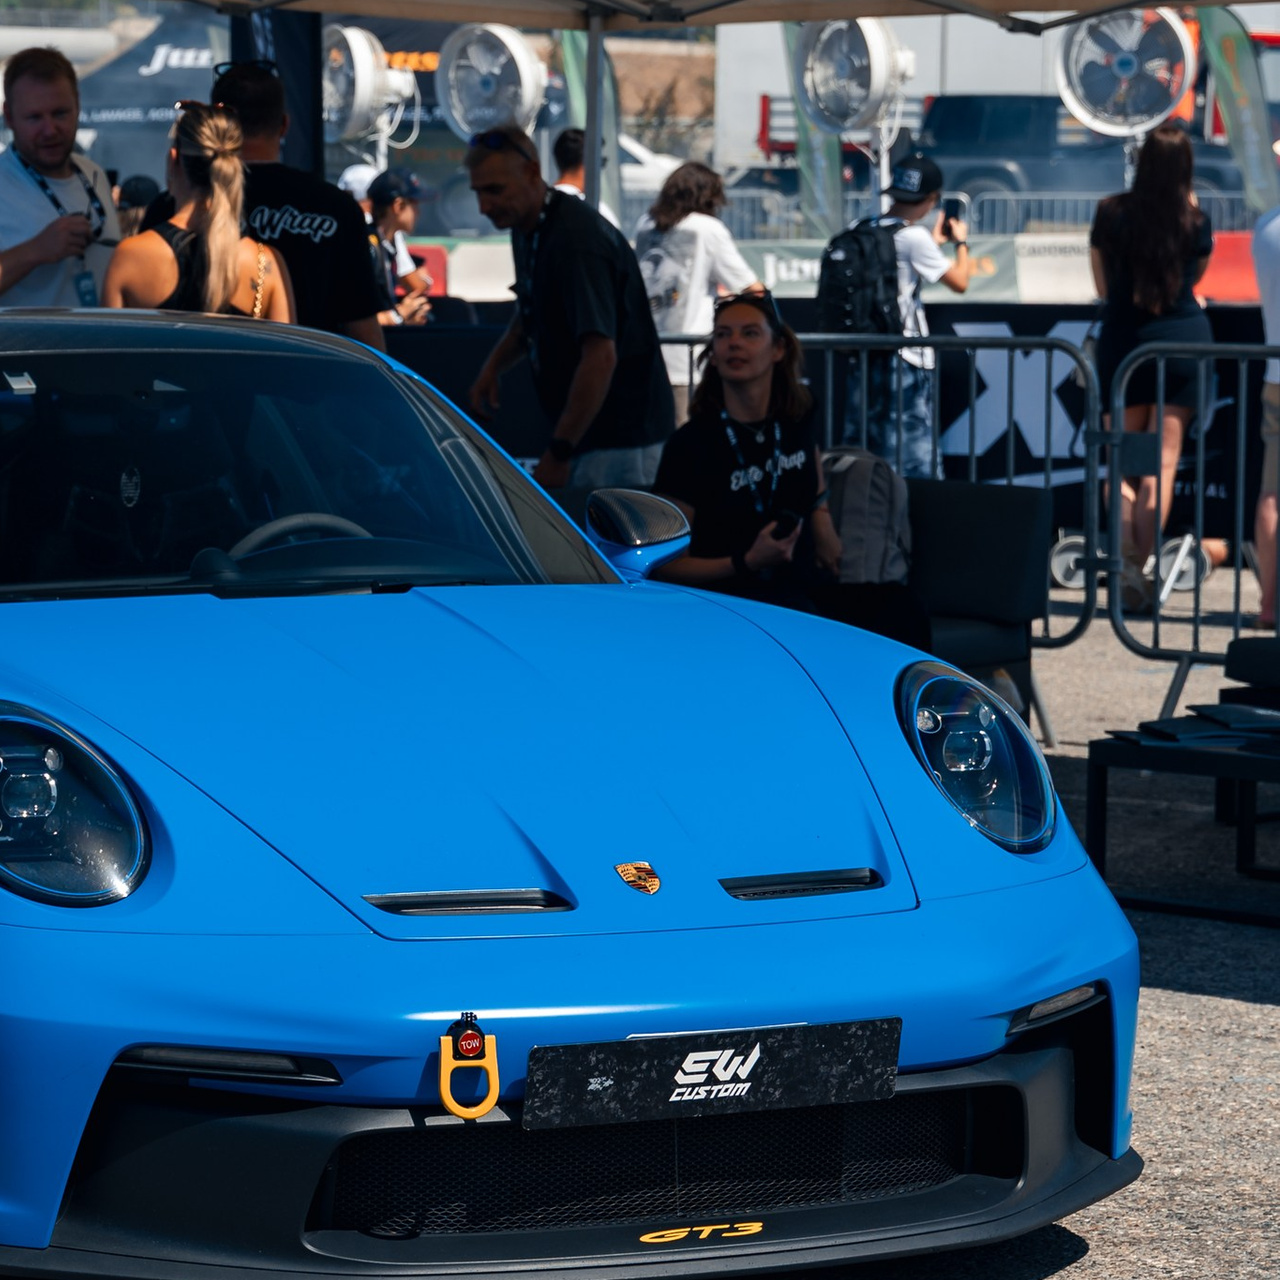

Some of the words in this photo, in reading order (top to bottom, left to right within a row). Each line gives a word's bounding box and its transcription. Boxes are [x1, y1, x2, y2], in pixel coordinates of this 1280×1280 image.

[249, 205, 338, 243] Wrap
[461, 1038, 480, 1050] TOW
[669, 1082, 752, 1102] CUSTOM
[639, 1222, 763, 1243] GT3
